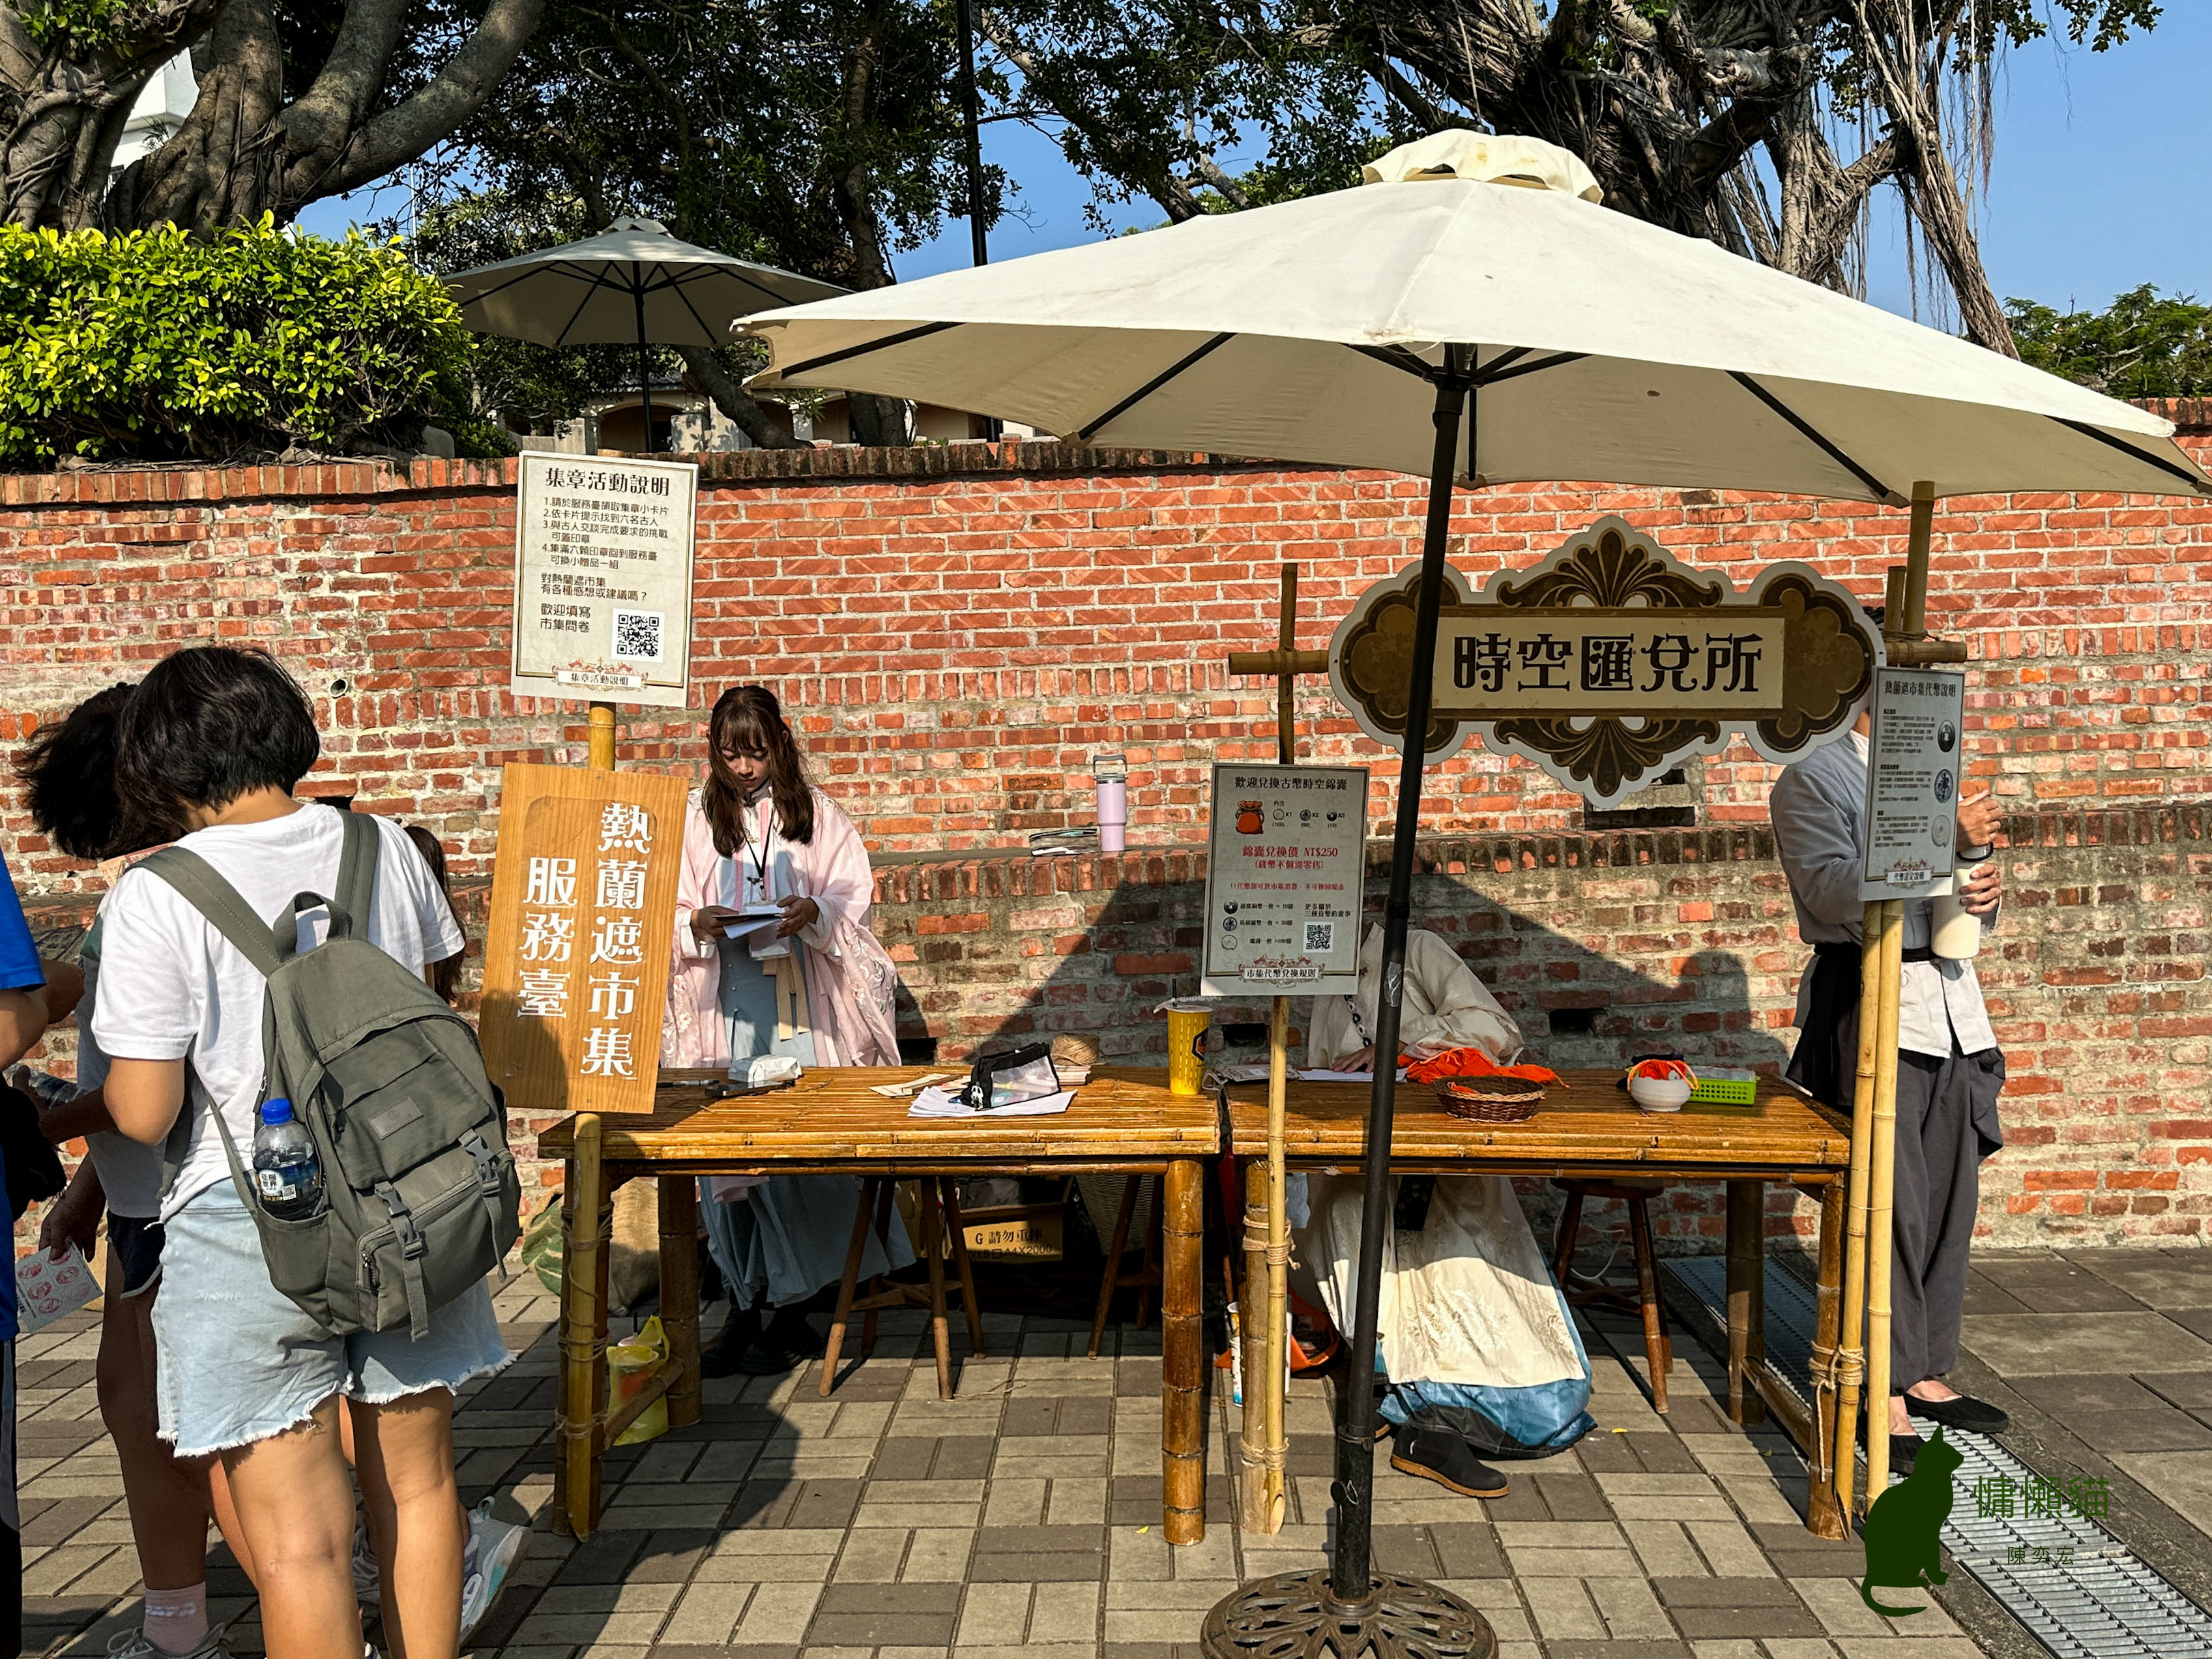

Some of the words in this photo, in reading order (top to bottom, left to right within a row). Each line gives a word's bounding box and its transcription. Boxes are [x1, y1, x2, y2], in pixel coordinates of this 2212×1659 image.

[545, 467, 669, 496] 集章活動說明
[544, 509, 658, 527] 2.依卡片提示找到六名古人
[551, 532, 590, 544] 可蓋印章
[551, 555, 618, 569] 可換小贈品一組
[541, 573, 605, 587] 對熱蘭遮市集
[540, 602, 590, 619] 歡迎填寫
[540, 618, 590, 633] 市集問卷
[1453, 633, 1764, 692] 時空匯兌所
[1303, 847, 1338, 857] NT$250
[517, 856, 577, 1018] 服務臺
[579, 802, 652, 1077] 熱蘭遮市集
